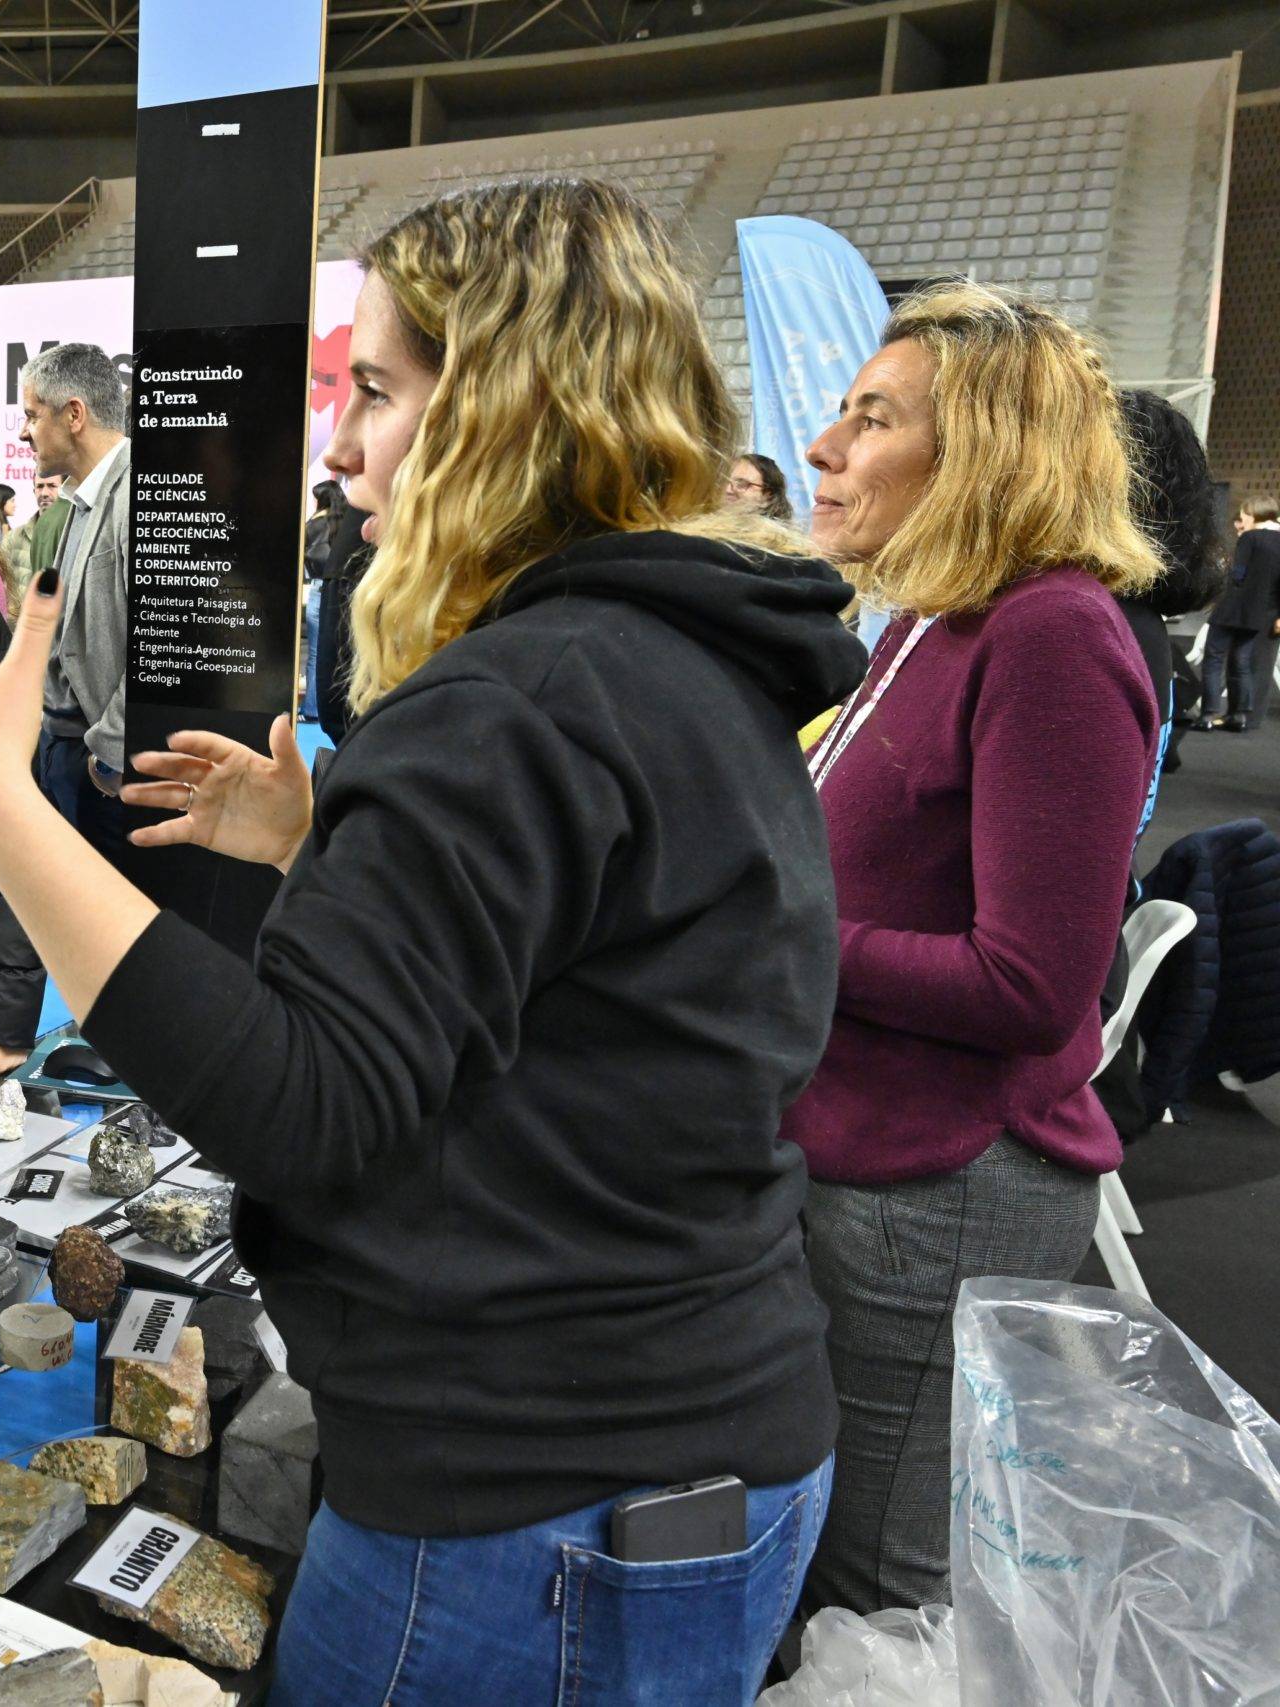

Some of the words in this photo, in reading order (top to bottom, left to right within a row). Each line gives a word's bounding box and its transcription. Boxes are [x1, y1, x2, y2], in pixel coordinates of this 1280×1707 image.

[140, 365, 243, 383] Construindo
[139, 394, 149, 406] a
[153, 390, 198, 405] Terra
[139, 413, 158, 428] de
[161, 412, 229, 428] amanhã
[137, 473, 204, 485] FACULDADE
[137, 490, 152, 501] DE
[154, 488, 207, 501] CIÊNCIAS
[136, 511, 226, 524] DEPARTAMENTO
[136, 527, 150, 538] DE
[152, 526, 230, 541] GEOCIÊNCIAS,
[135, 543, 191, 555] AMBIENTE
[135, 559, 142, 569] E
[144, 559, 232, 572] ORDENAMENTO
[135, 575, 152, 585] DO
[154, 574, 219, 587] TERRITÓRIO
[140, 595, 194, 608] Arquitetura
[197, 597, 247, 611] Paisagista
[140, 611, 180, 623] Ciências
[182, 615, 189, 623] e
[190, 612, 245, 628] Tecnologia
[248, 616, 261, 627] do
[133, 625, 180, 638] Ambiente
[139, 641, 193, 655] Engenharia
[195, 645, 256, 658] Agronómica
[139, 657, 192, 670] Engenharia
[195, 660, 256, 674] Geoespacial
[138, 672, 181, 686] Geologia
[133, 1298, 175, 1354] MÁRMORE
[109, 1526, 180, 1593] GRANITO
